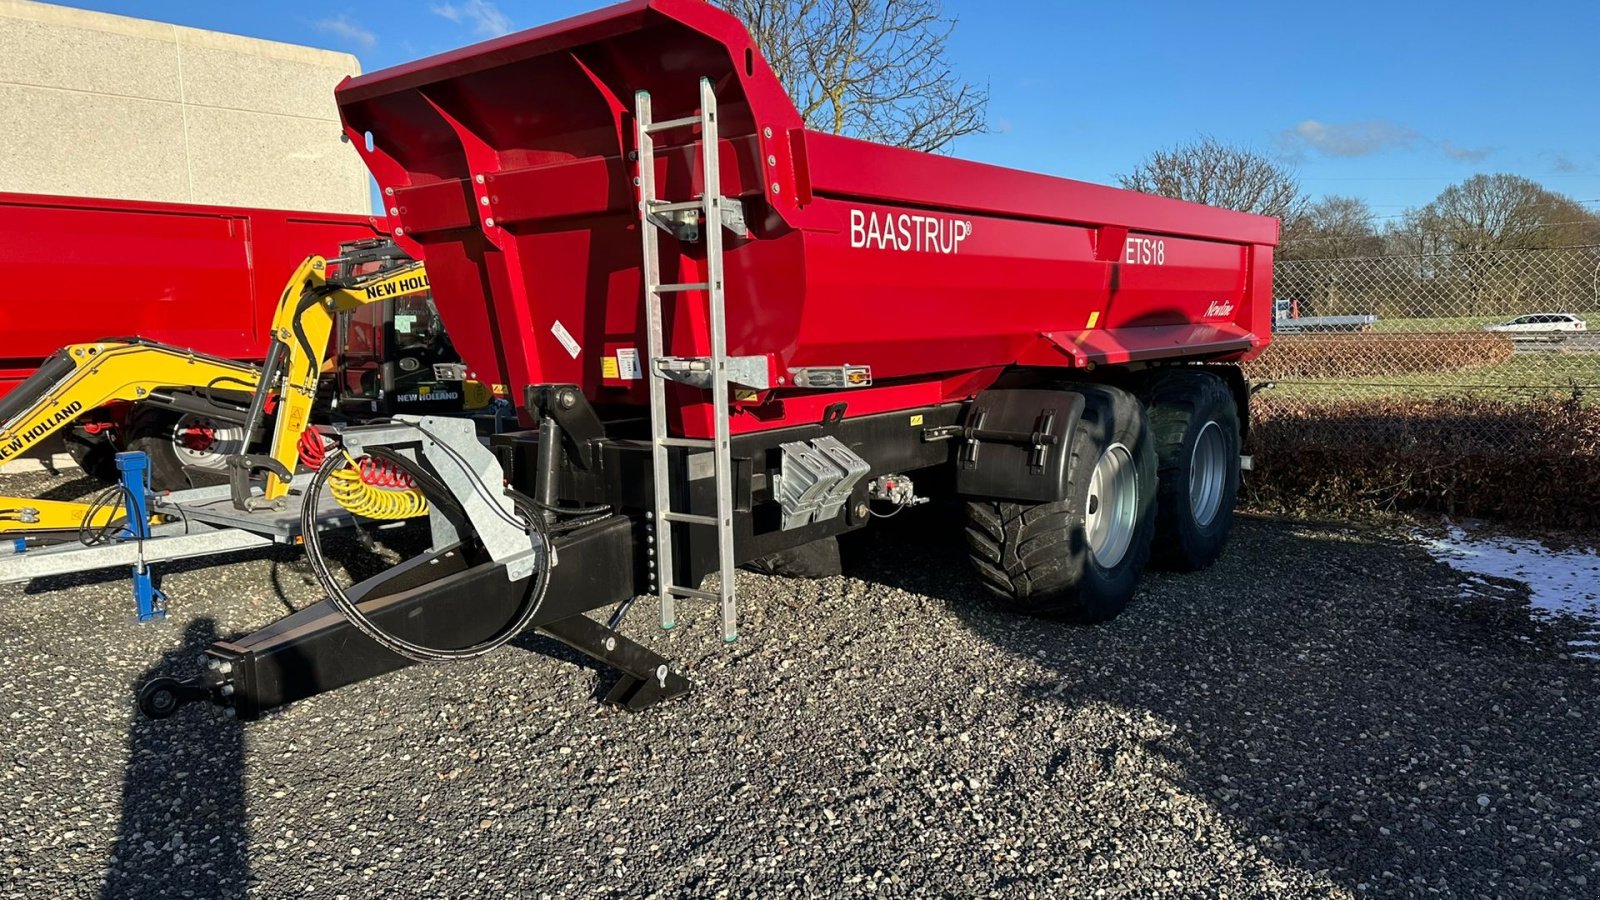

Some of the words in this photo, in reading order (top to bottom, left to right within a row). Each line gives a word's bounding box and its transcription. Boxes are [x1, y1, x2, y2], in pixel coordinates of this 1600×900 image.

[1125, 237, 1165, 266] ETS18
[366, 282, 396, 299] NEW
[397, 393, 418, 402] NEW
[419, 392, 458, 401] HOLLAND
[22, 401, 82, 443] HOLLAND
